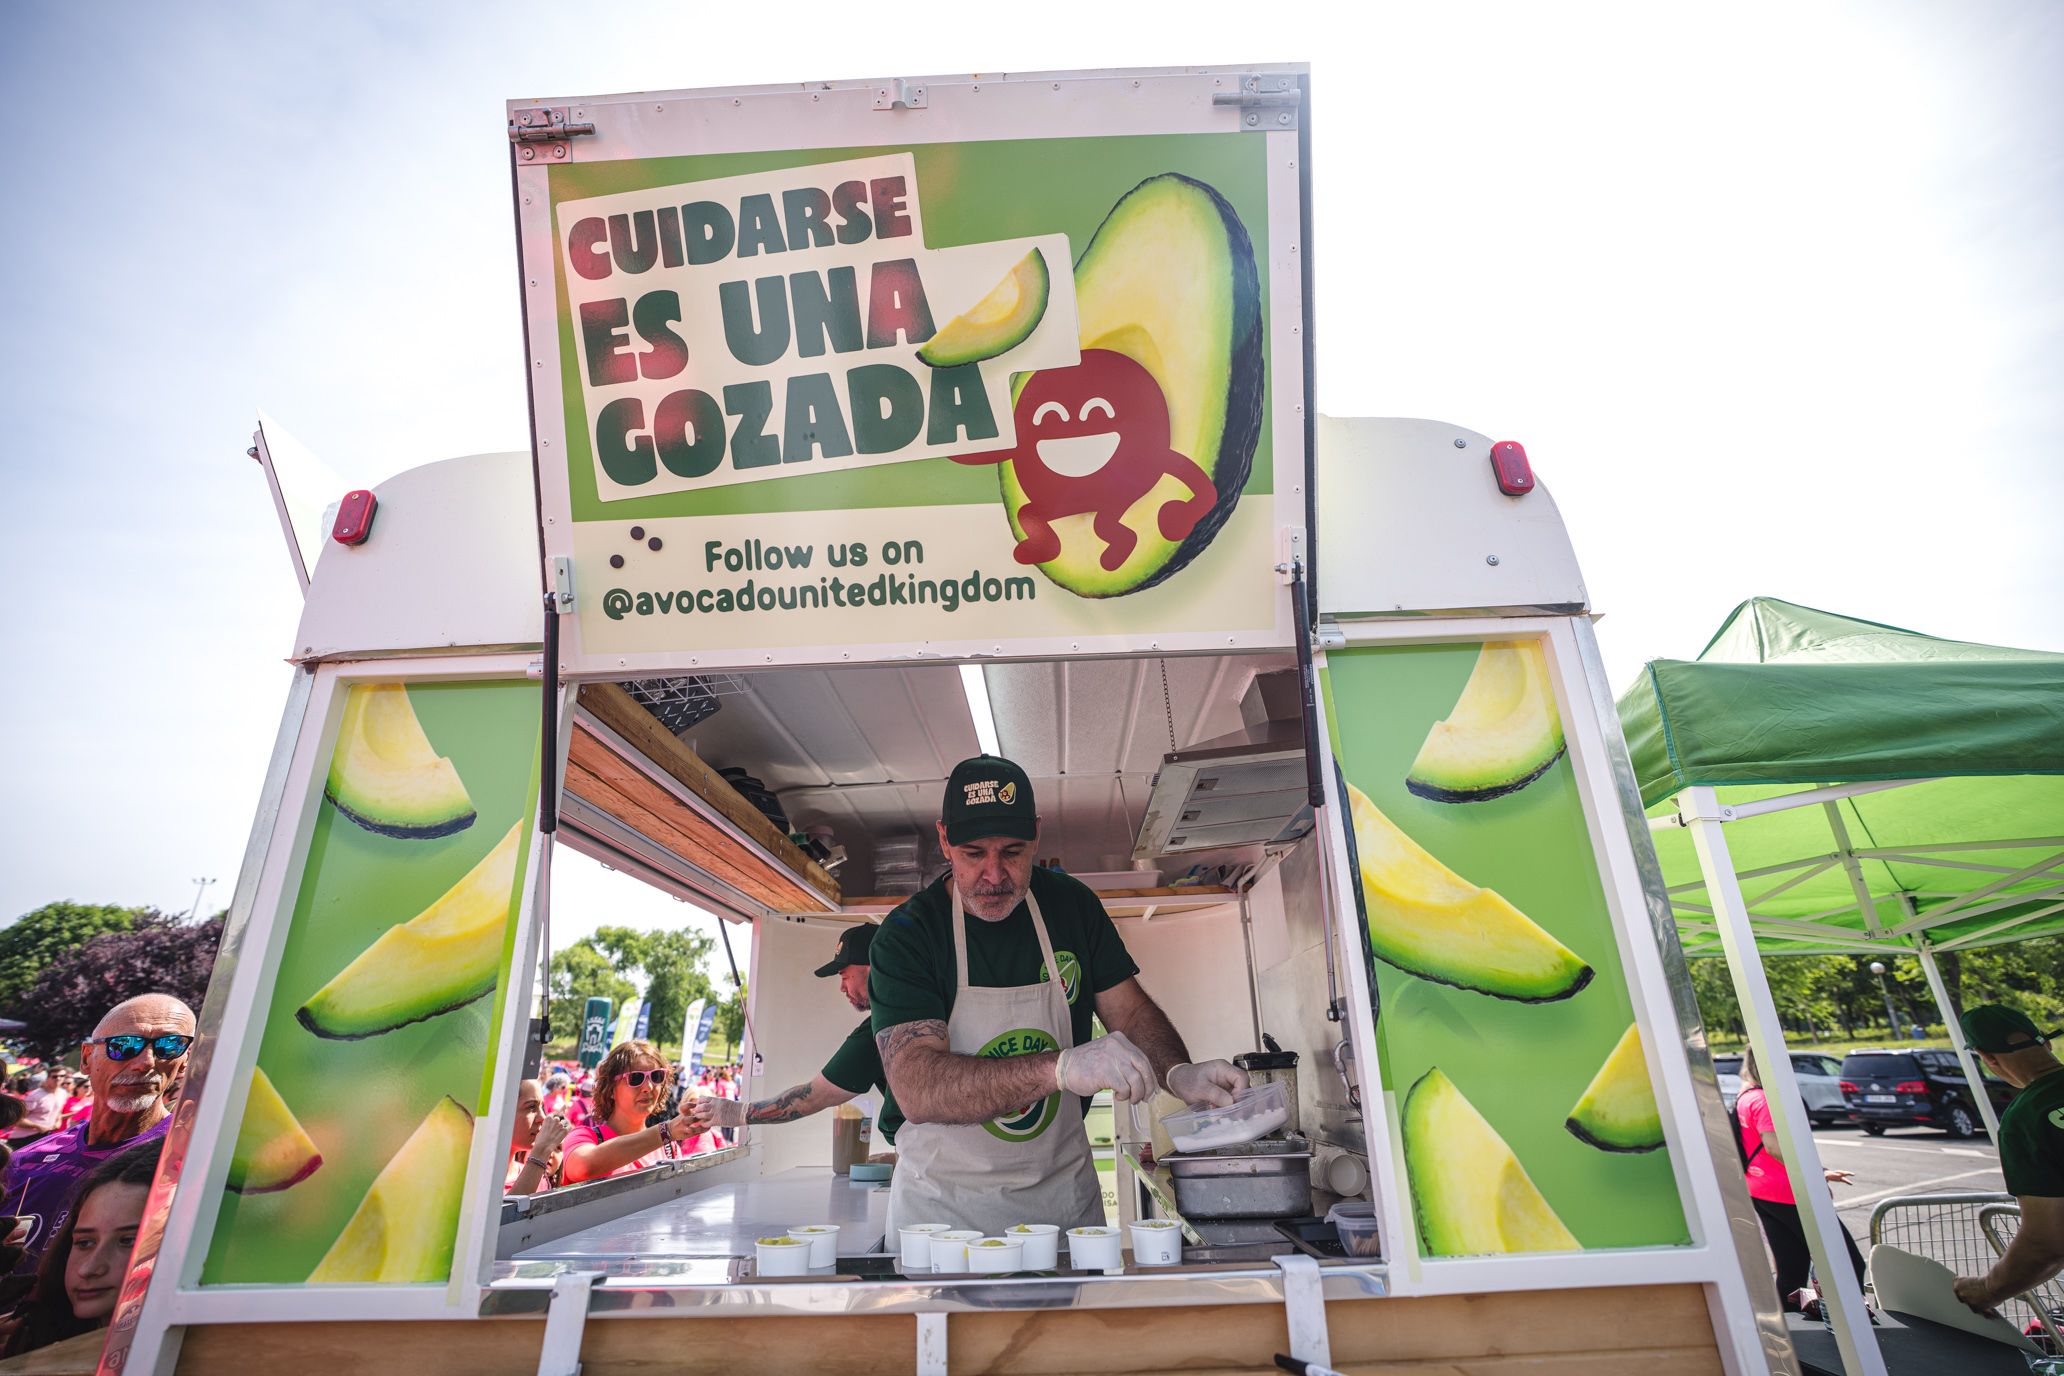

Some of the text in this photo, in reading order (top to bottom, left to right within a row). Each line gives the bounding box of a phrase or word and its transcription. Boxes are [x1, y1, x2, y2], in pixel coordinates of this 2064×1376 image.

[568, 175, 912, 281] CUIDARSE
[579, 257, 938, 387] ES UNA
[595, 362, 1000, 487] GOZADA
[704, 538, 924, 573] Follow us on
[602, 569, 1036, 621] @avocadounitedkingdom
[963, 780, 999, 792] CUIDARSE
[966, 795, 997, 806] GOZADA
[968, 788, 994, 799] ES UNA
[1022, 1035, 1049, 1052] DAY
